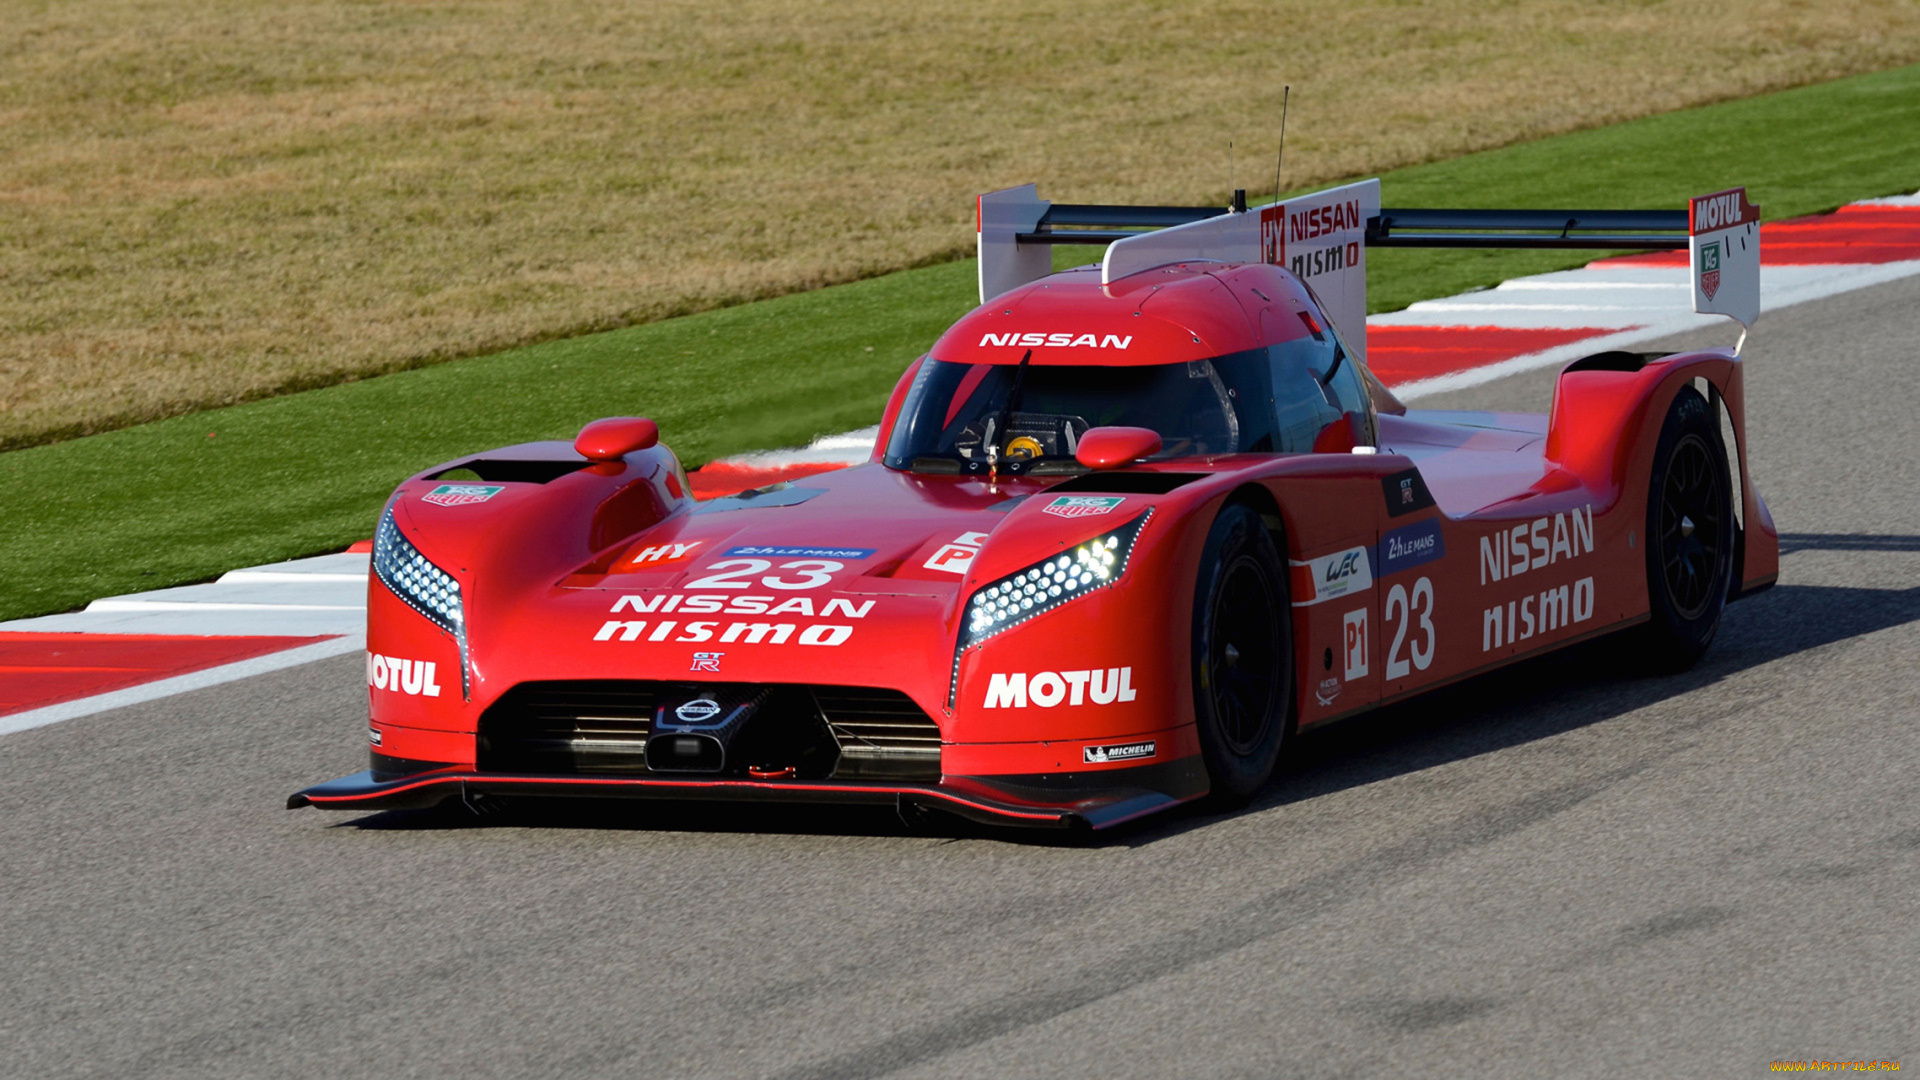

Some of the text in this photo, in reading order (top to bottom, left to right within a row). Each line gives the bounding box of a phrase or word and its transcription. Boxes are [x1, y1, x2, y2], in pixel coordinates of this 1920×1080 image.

[1291, 199, 1358, 243] NISSAN
[1694, 192, 1742, 231] MOTUL
[1292, 241, 1358, 279] nismo
[1703, 247, 1717, 270] TAG
[1702, 272, 1719, 296] HEUER
[979, 332, 1133, 350] NISSAN
[632, 541, 703, 564] HY
[1403, 541, 1414, 555] LE
[1413, 534, 1435, 553] MANS
[1480, 503, 1594, 586] NISSAN
[683, 558, 845, 590] 23
[1326, 551, 1360, 582] WEC
[609, 595, 876, 618] NISSAN
[1482, 576, 1595, 652] nismo
[593, 620, 854, 647] nismo
[1346, 617, 1367, 671] P1
[1385, 576, 1436, 681] 23
[983, 666, 1137, 709] MOTUL
[680, 706, 717, 714] NISSAN
[1108, 744, 1156, 756] MICHELIN
